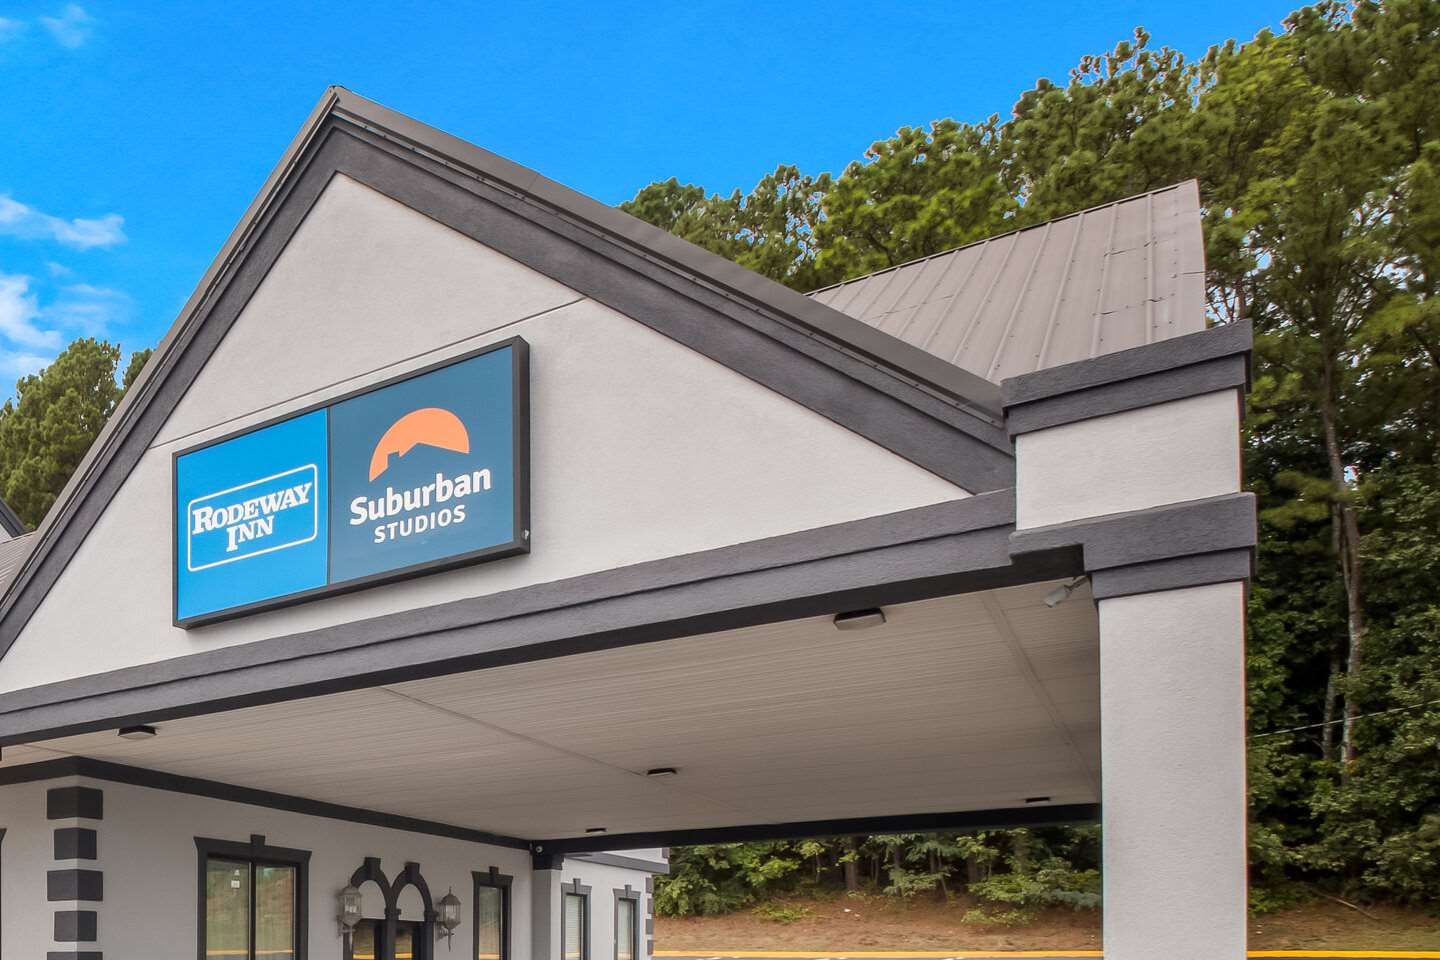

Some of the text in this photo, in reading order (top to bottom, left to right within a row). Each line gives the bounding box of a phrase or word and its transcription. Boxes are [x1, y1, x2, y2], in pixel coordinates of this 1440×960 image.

[192, 482, 312, 534] RODEWAY
[349, 468, 491, 526] Suburban
[226, 515, 274, 552] INN
[374, 504, 466, 543] STUDIOS
